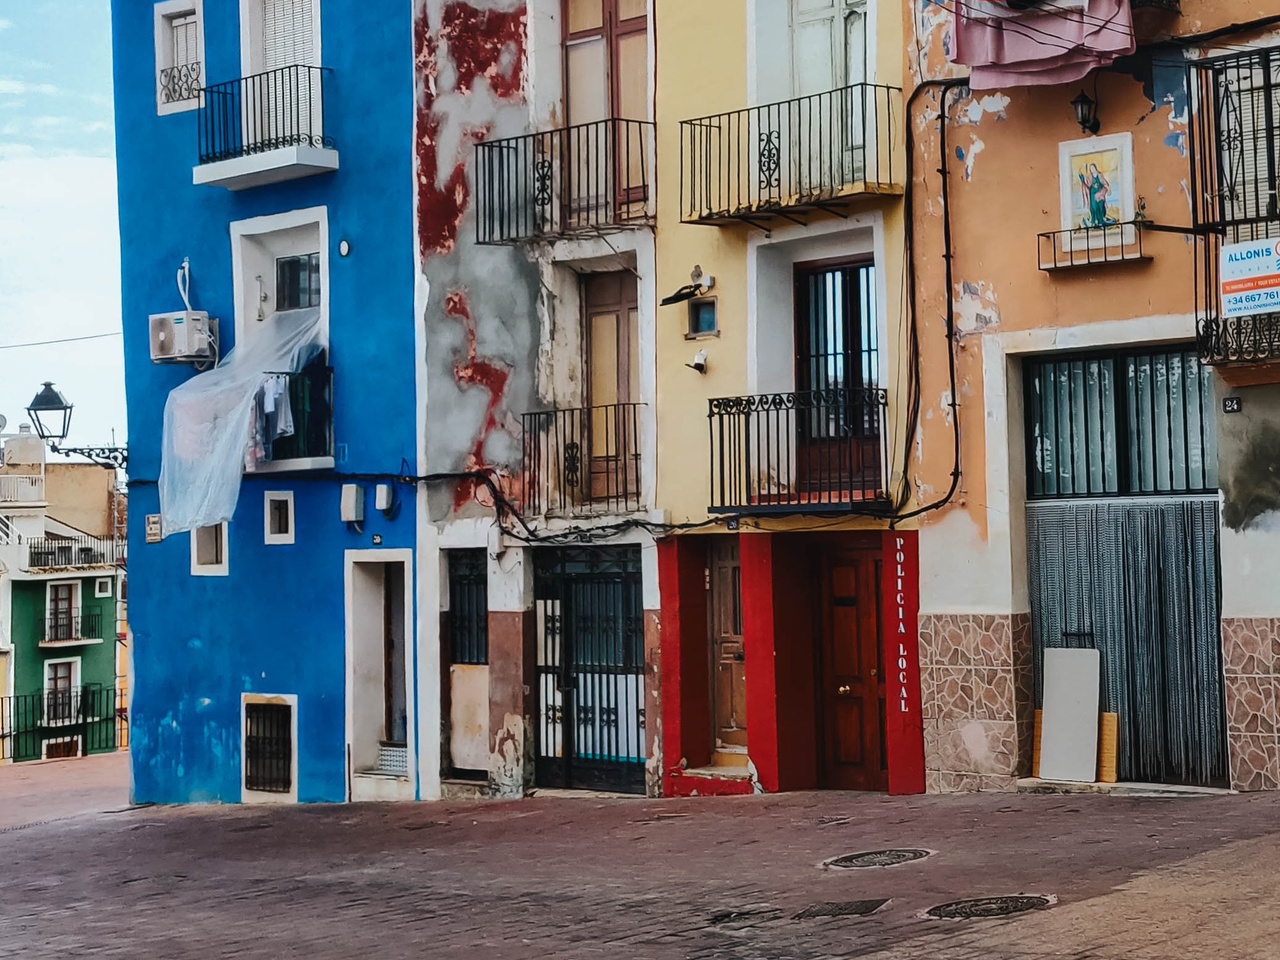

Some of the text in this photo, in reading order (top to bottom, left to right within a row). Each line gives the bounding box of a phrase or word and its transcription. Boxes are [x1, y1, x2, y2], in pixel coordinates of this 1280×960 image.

[1228, 247, 1272, 263] ALLONIS
[1227, 296, 1243, 305] +34
[1245, 294, 1262, 303] 667
[1264, 291, 1279, 300] 761
[1225, 400, 1238, 411] 24
[895, 537, 909, 712] POLICIA LOCAL
